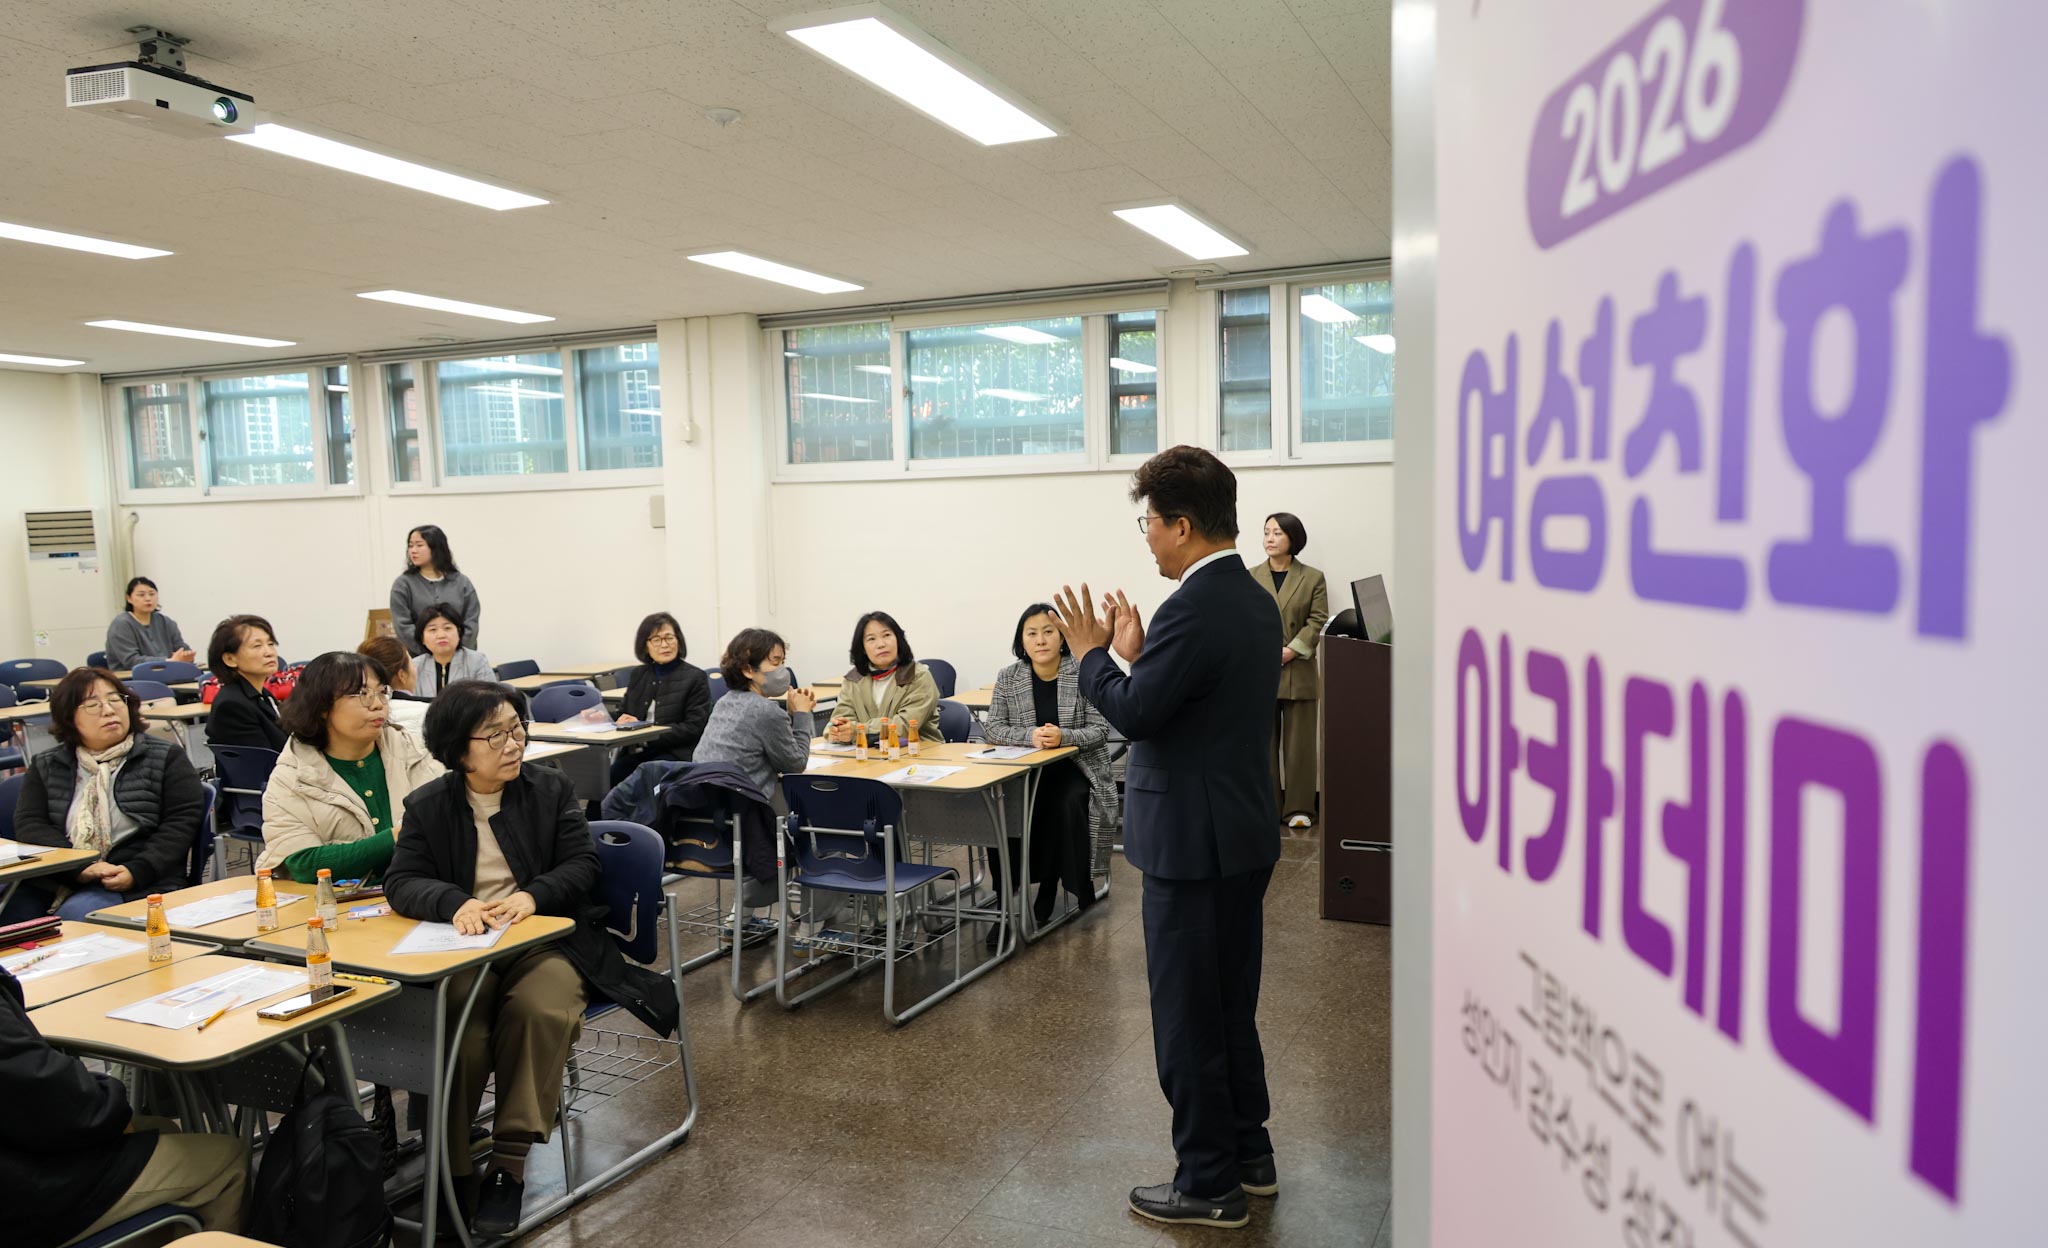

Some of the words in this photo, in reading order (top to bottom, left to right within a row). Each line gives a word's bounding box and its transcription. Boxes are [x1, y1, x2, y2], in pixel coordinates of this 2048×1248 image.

[1560, 0, 1741, 218] 2026
[1457, 153, 2014, 640] 여성친화
[1456, 627, 1972, 1208] 아카데미
[1517, 951, 1665, 1155] 그림책으로
[1676, 1099, 1768, 1248] 여는
